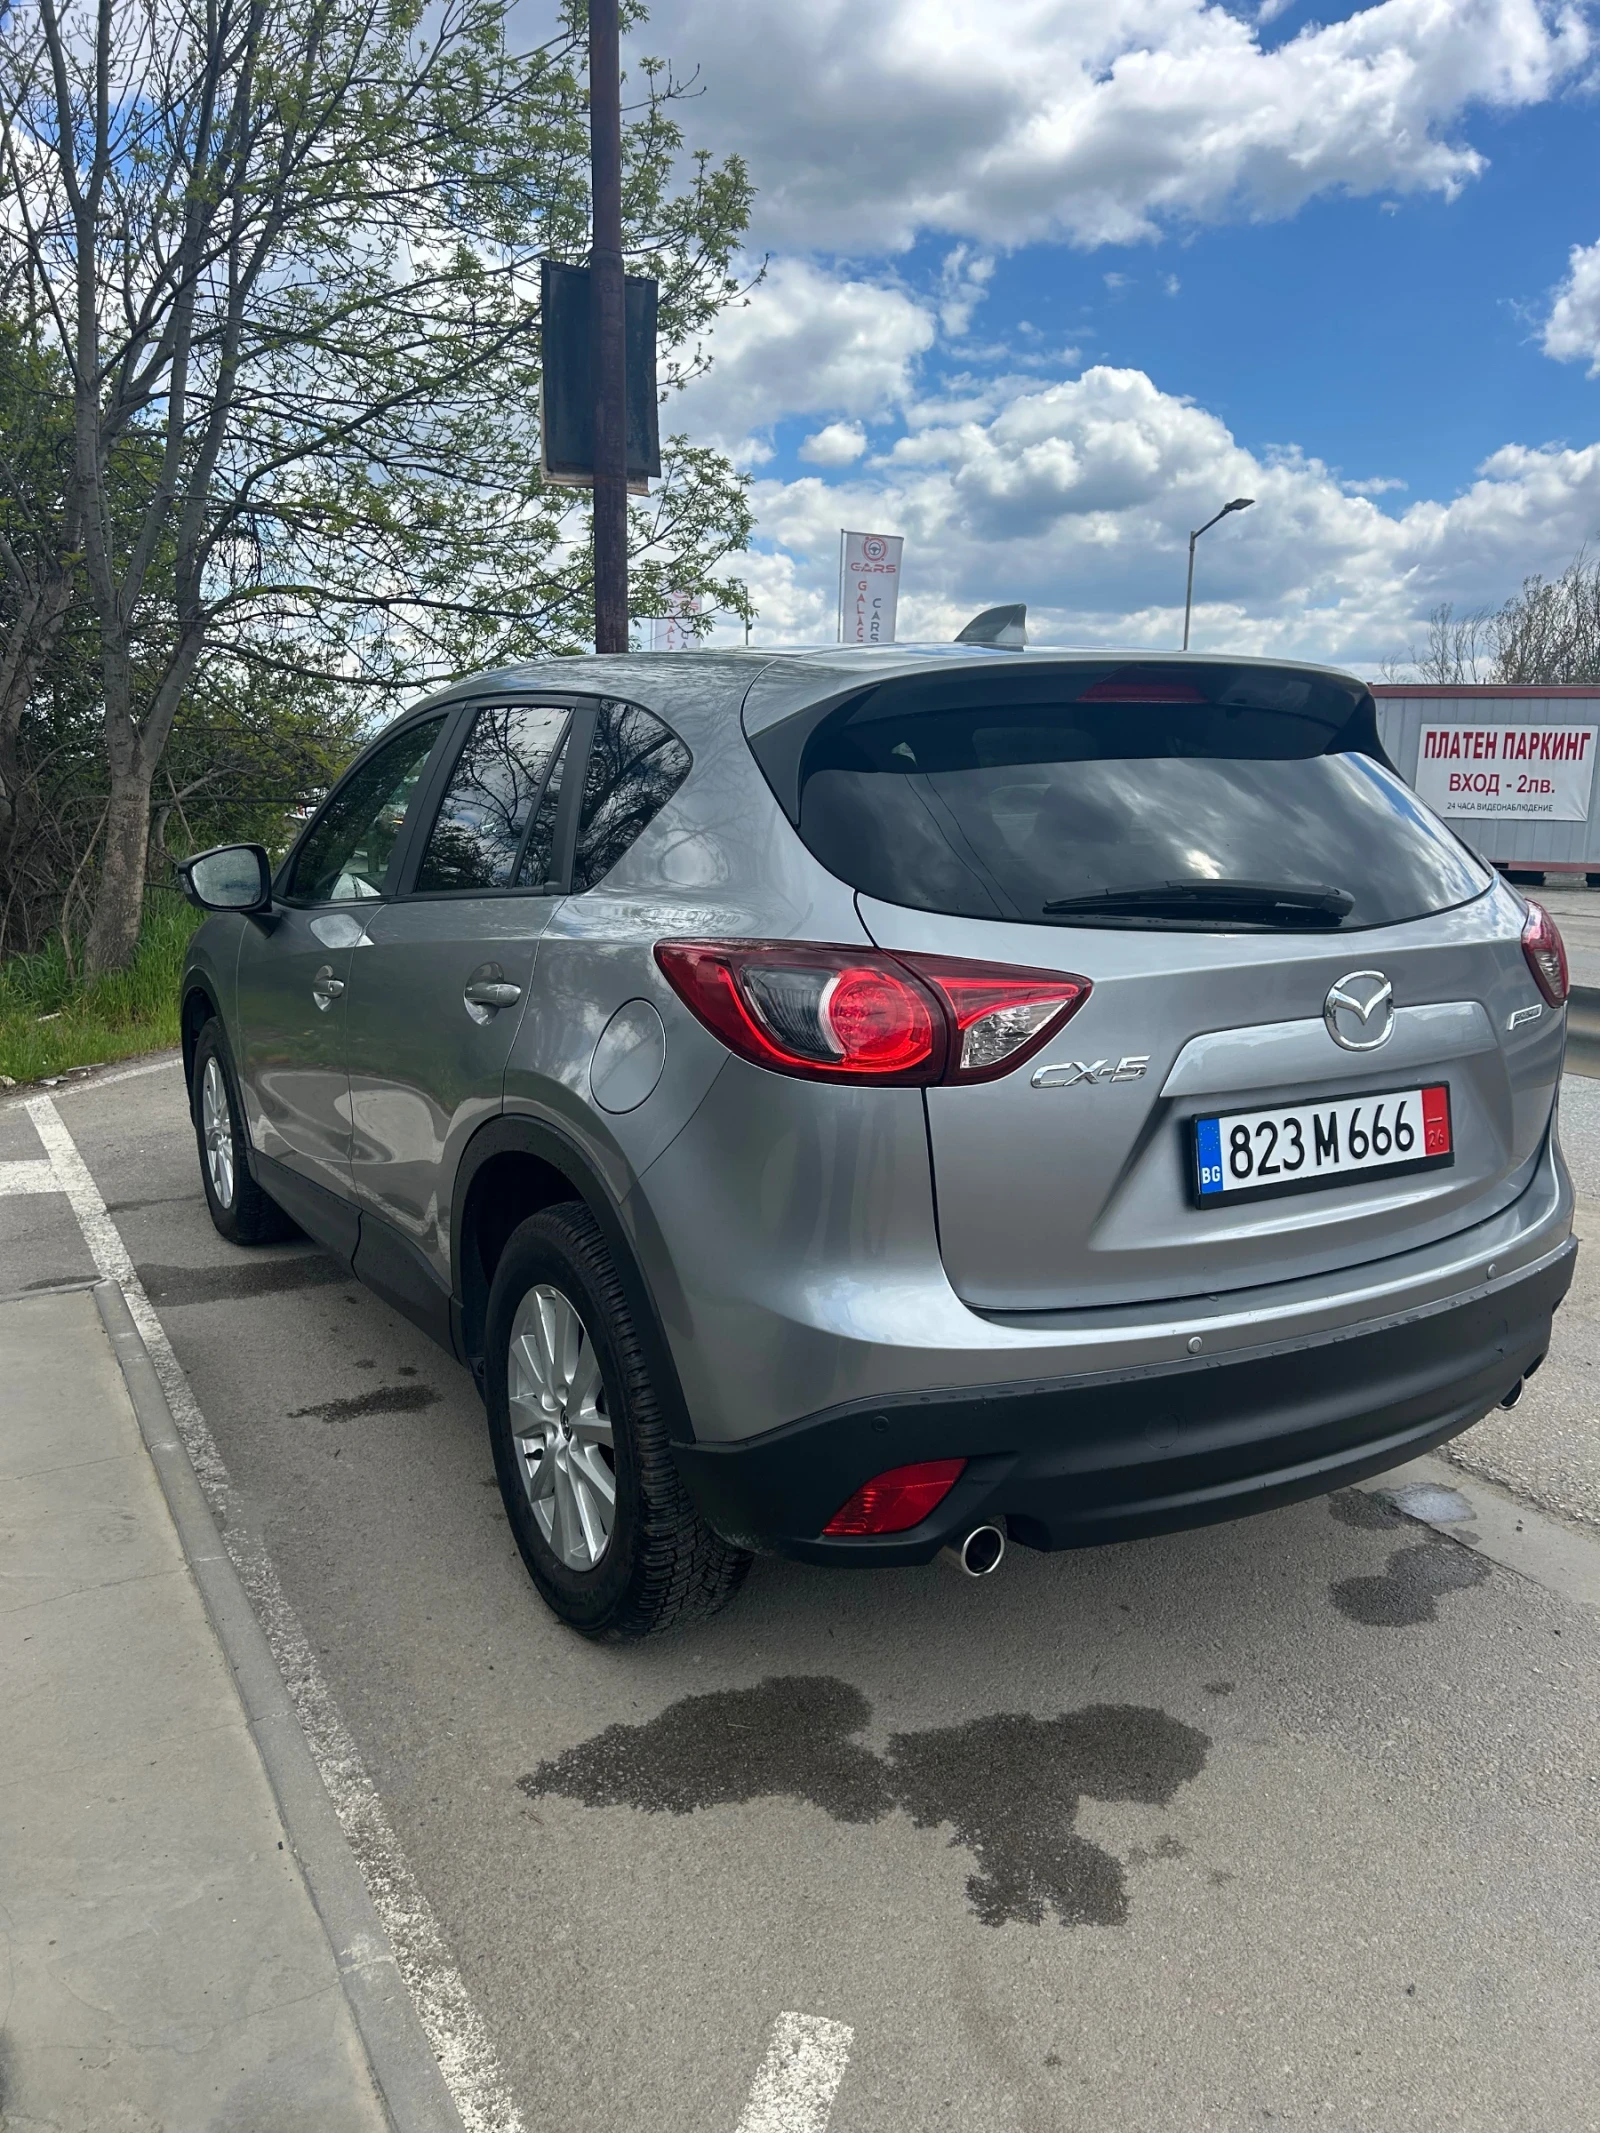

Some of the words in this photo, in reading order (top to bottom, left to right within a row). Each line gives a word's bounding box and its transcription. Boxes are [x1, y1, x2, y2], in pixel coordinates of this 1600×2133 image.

[1424, 732, 1497, 759] ПЛАТЕН
[1502, 732, 1591, 760] ПАРКИНГ
[1449, 773, 1500, 796] ВХОД
[1517, 774, 1556, 794] 2лв.
[1447, 802, 1457, 810] 24
[1457, 802, 1476, 811] ЧАСА
[1477, 803, 1554, 812] ВИДЕОНАБЛЮДЕНИЕ
[1031, 1055, 1150, 1088] CX-5
[1229, 1117, 1304, 1179] 823
[1349, 1100, 1415, 1160] 666
[1428, 1129, 1445, 1148] 26
[1202, 1165, 1221, 1184] BG
